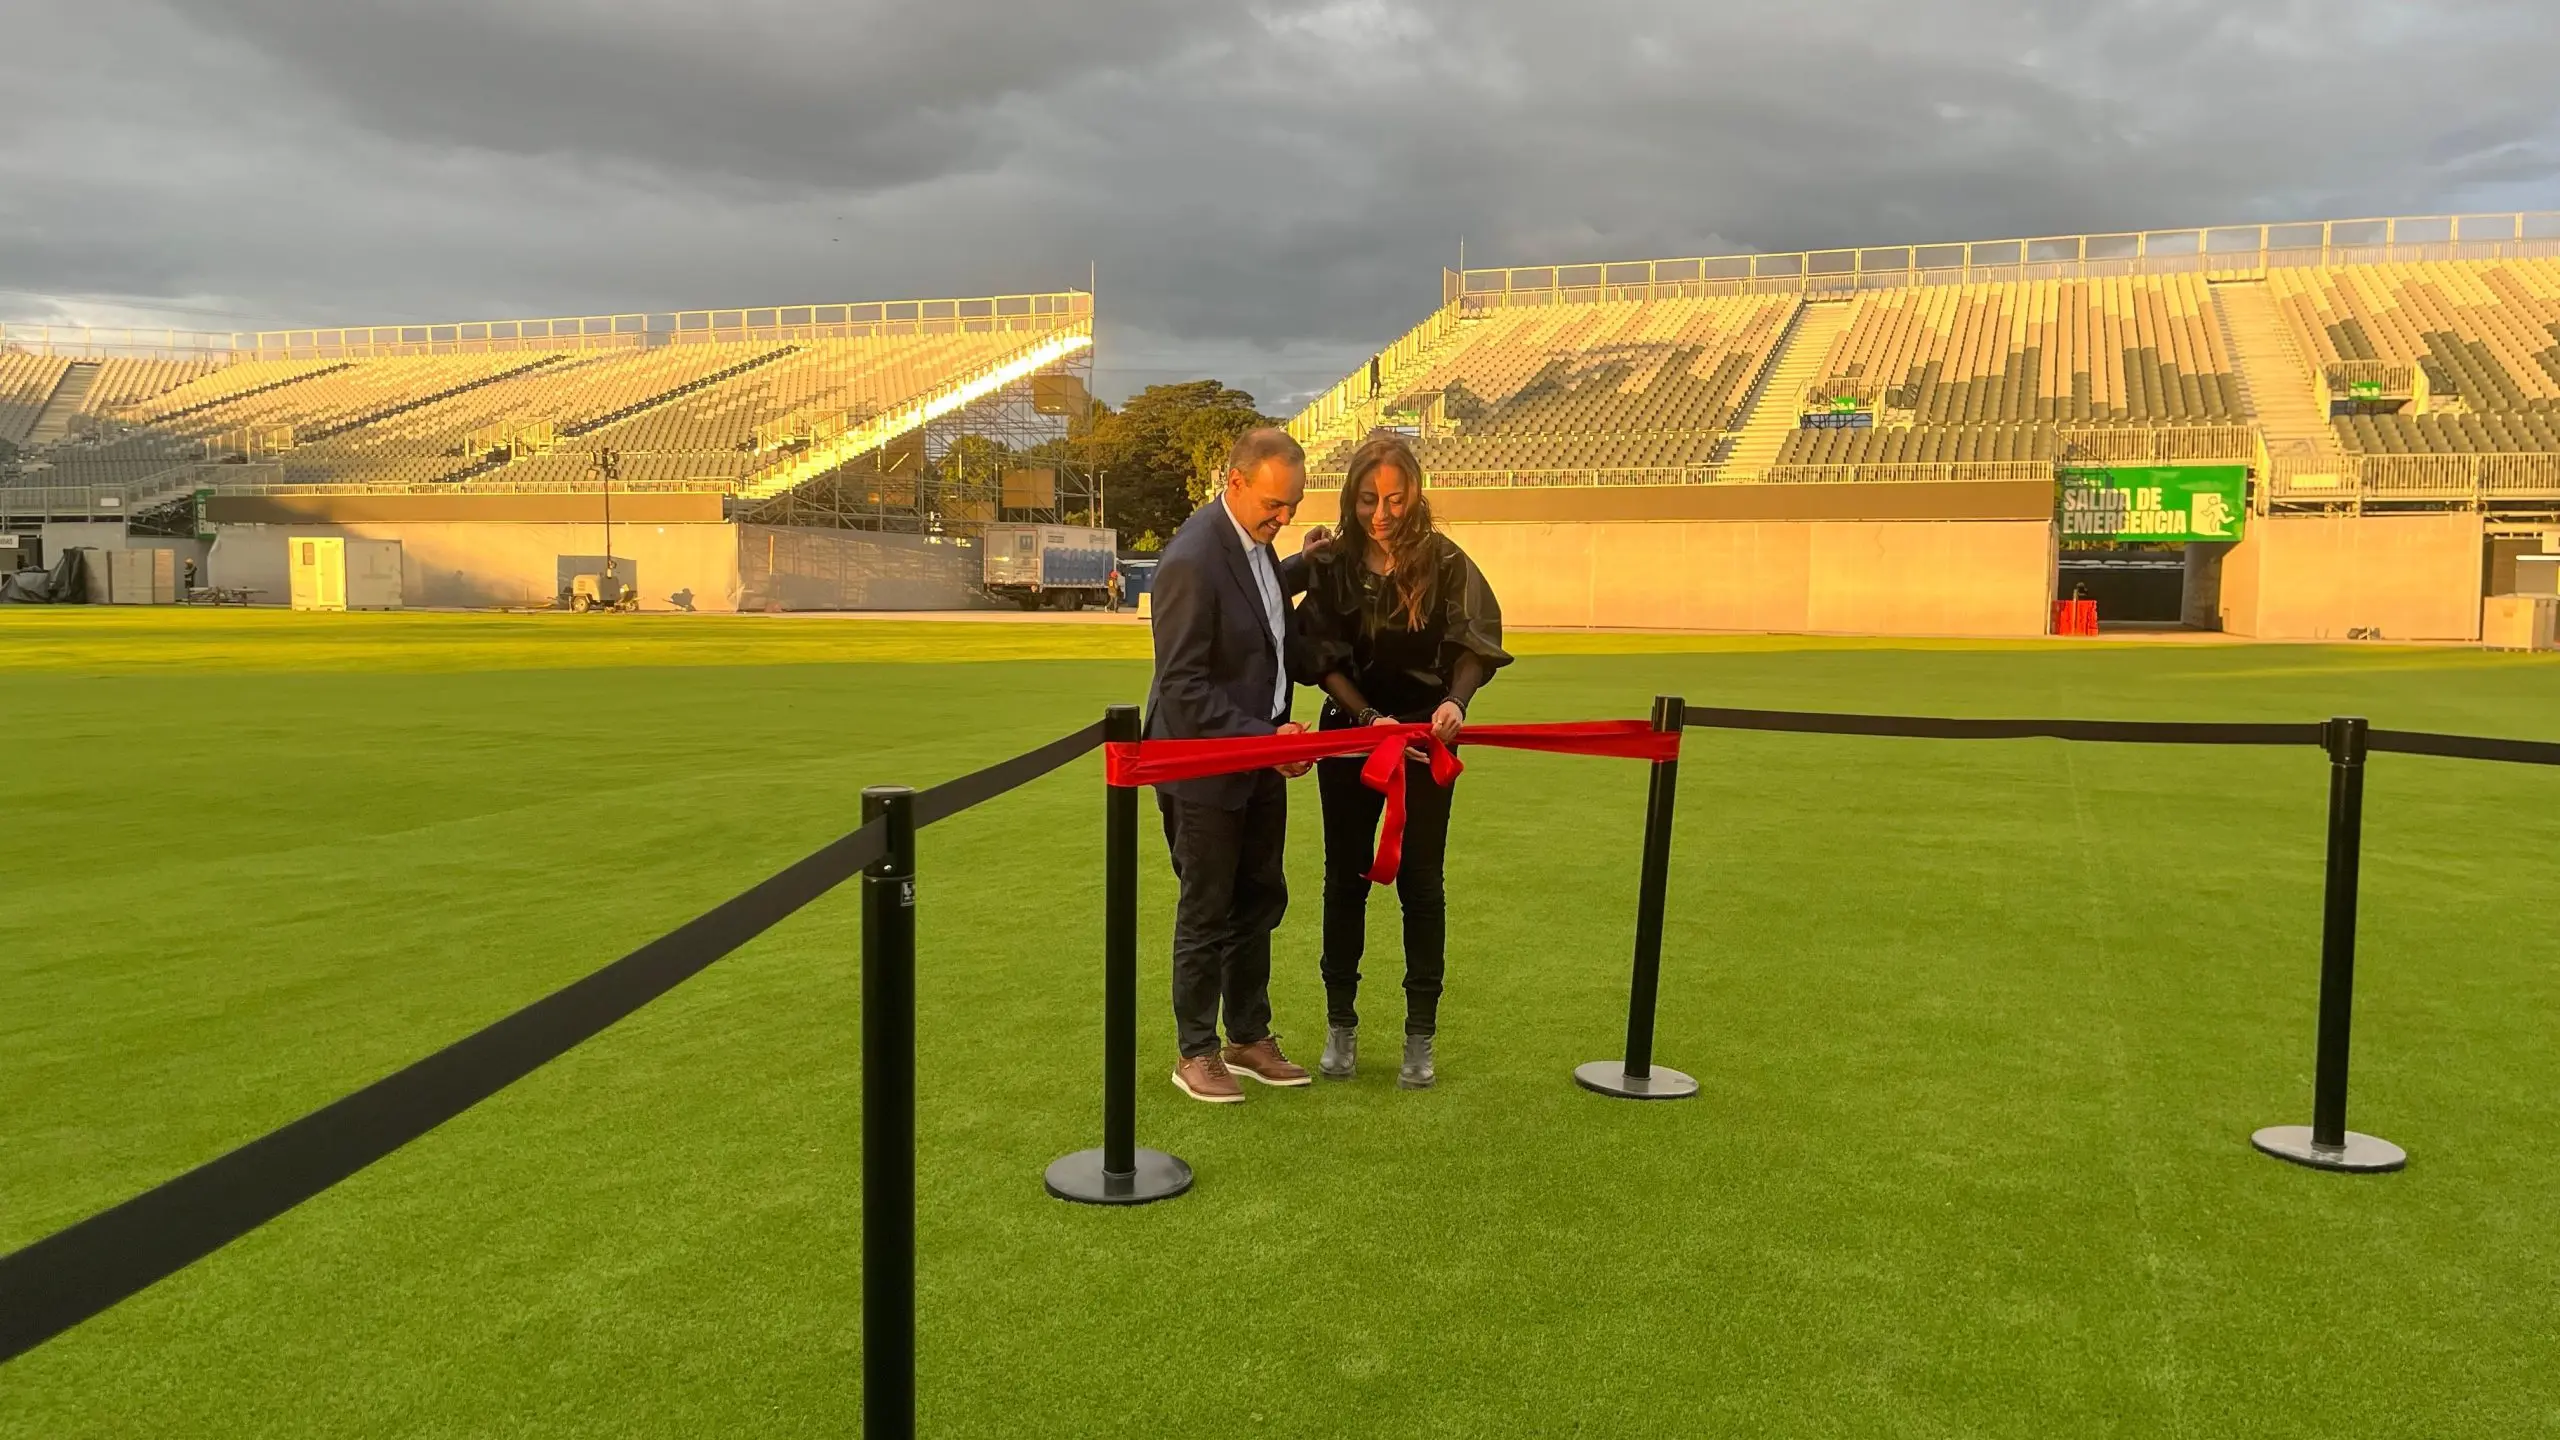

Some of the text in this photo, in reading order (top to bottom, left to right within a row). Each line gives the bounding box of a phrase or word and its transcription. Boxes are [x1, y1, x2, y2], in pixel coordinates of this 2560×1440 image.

[2063, 487, 2162, 511] SALIDA DE
[2062, 510, 2187, 535] EMERGENCIA
